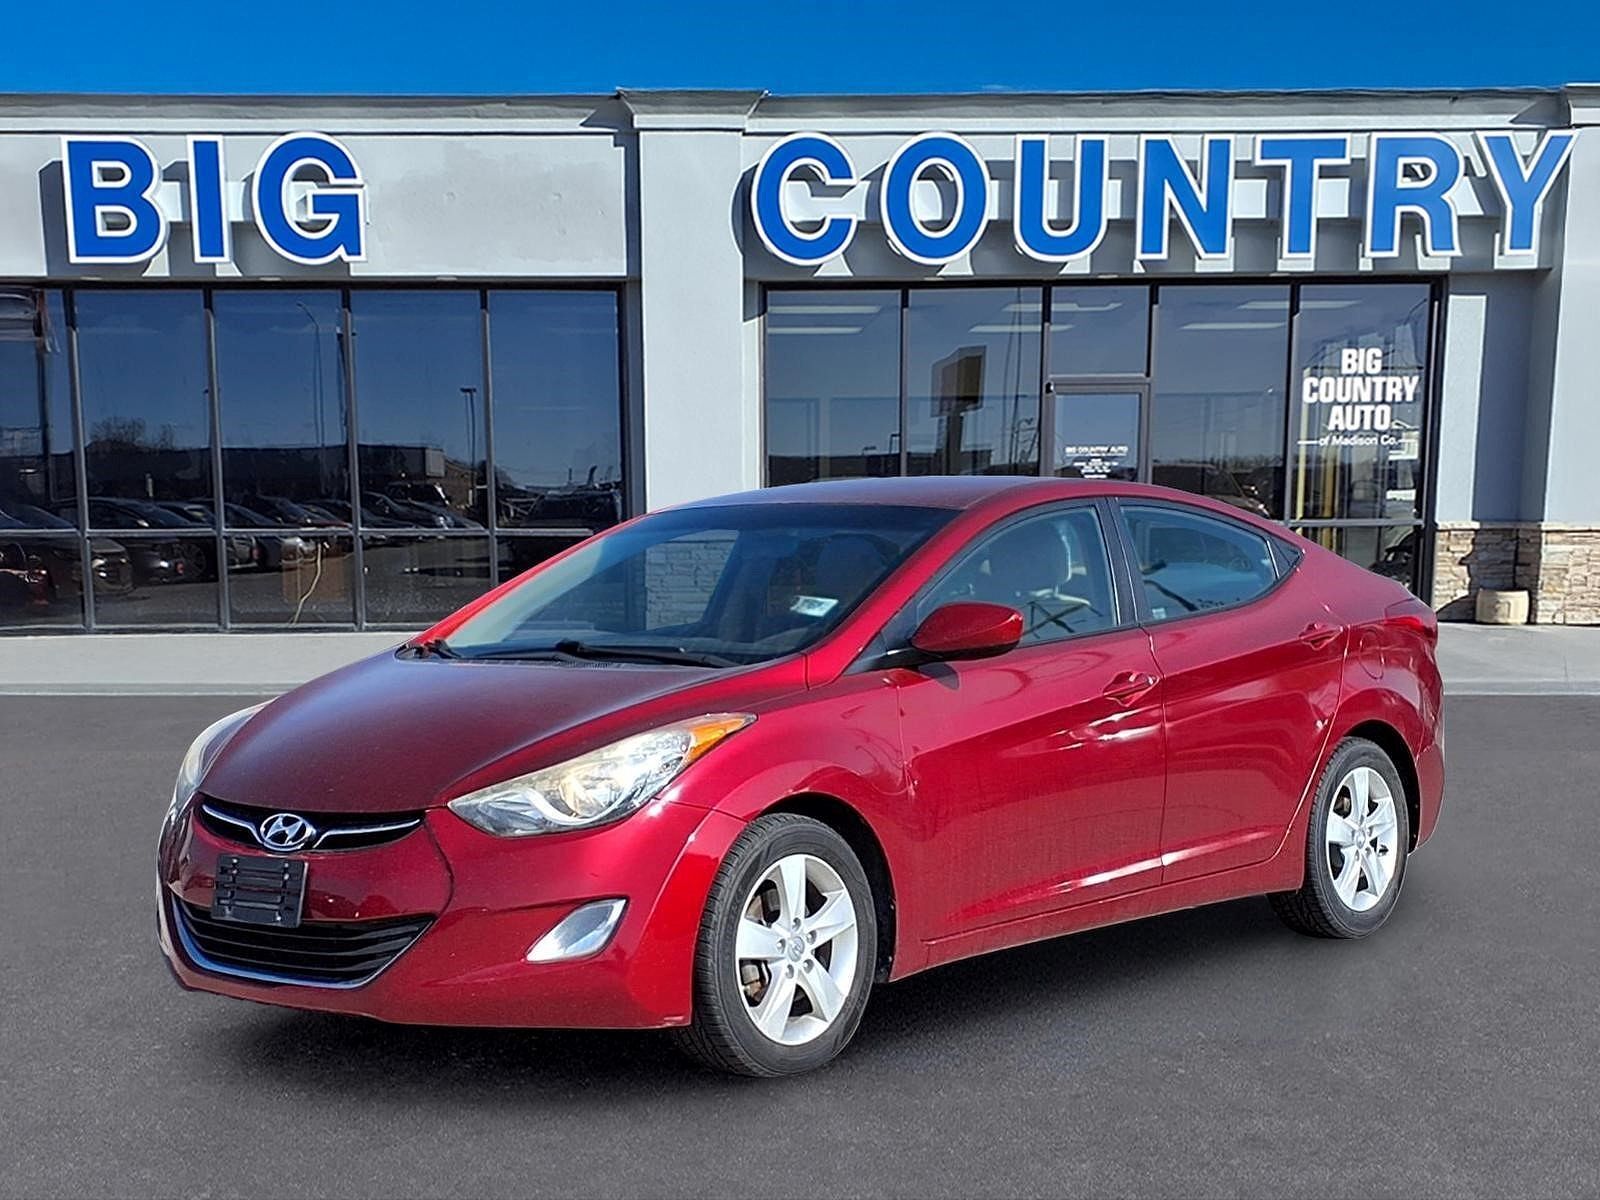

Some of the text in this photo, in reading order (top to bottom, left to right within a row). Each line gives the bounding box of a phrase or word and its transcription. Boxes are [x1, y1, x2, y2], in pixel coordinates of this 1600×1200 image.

[62, 130, 1574, 266] BIG COUNTRY
[1341, 348, 1383, 375] BIG
[1302, 376, 1420, 403] COUNTRY
[1328, 404, 1391, 431] AUTO
[1320, 434, 1330, 446] of
[1331, 434, 1378, 446] Madison
